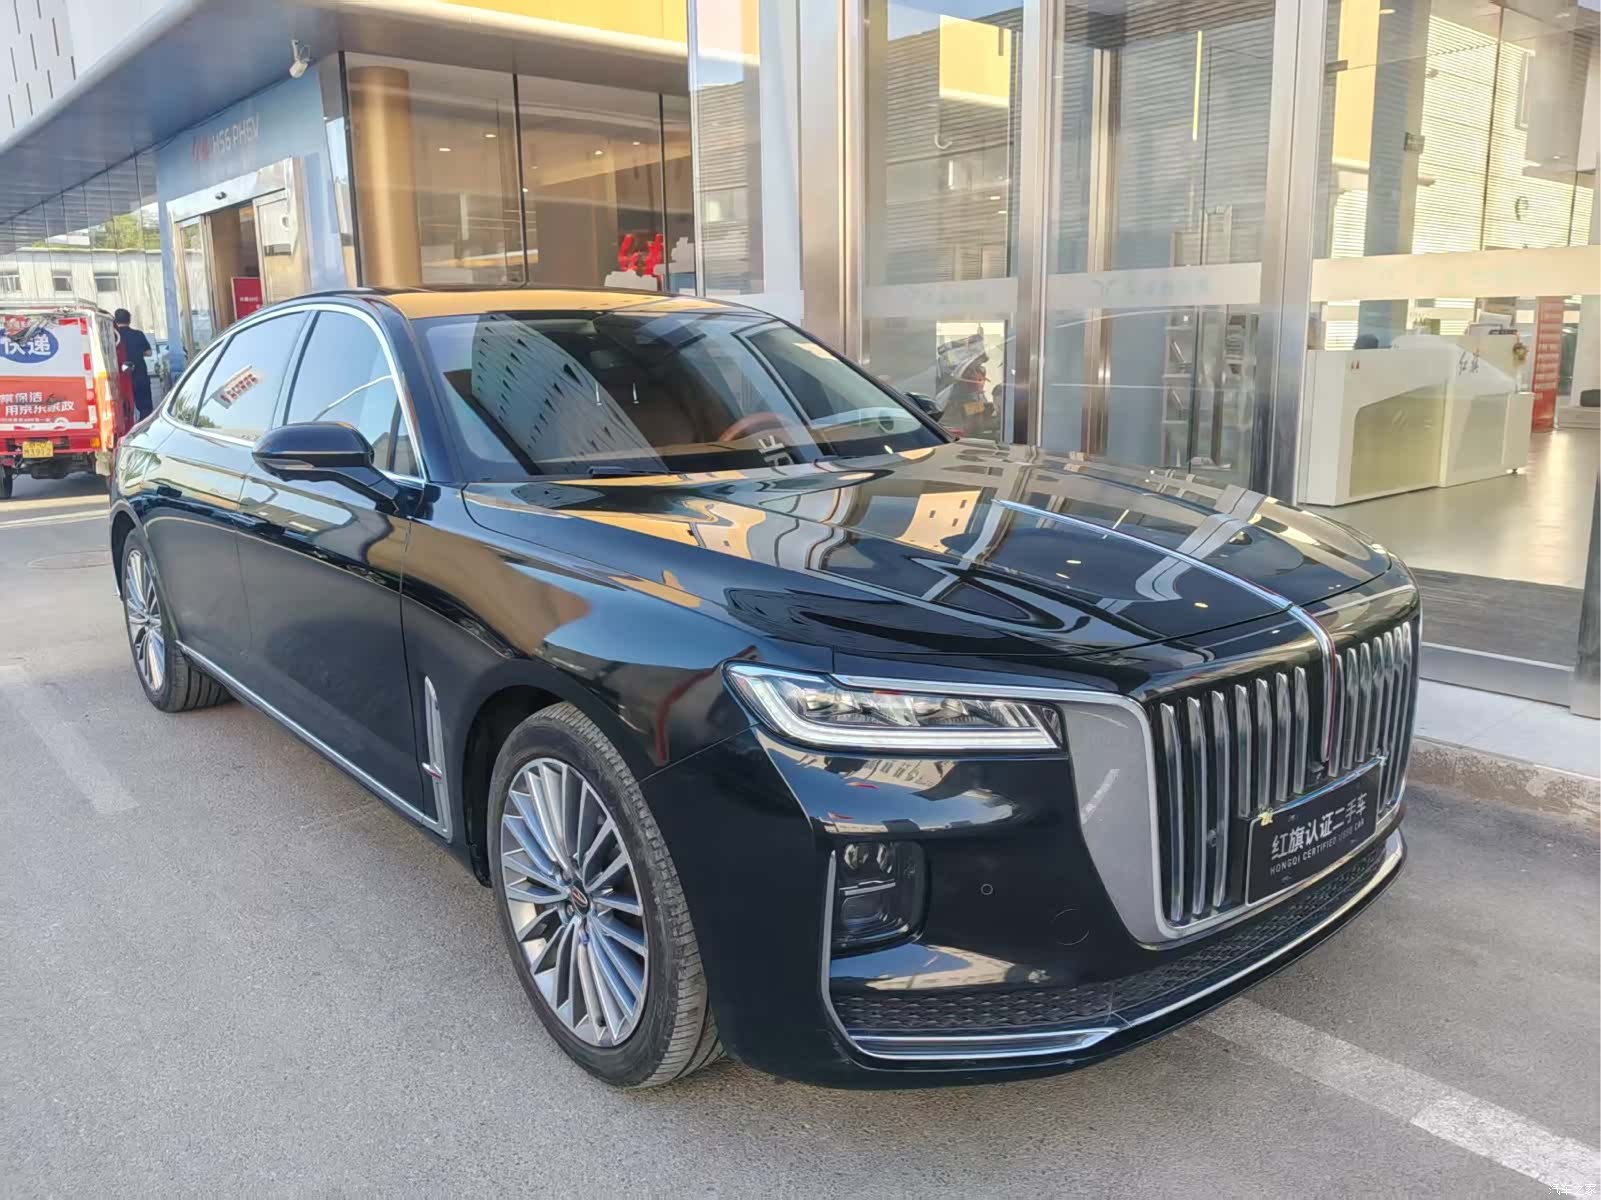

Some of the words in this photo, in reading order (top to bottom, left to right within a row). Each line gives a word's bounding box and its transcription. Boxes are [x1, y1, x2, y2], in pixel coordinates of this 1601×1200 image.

[1270, 856, 1300, 875] HONGQI
[1302, 837, 1337, 860] CERTIFIED
[1354, 817, 1365, 831] CAR
[1271, 792, 1367, 860] 红旗认证二手车
